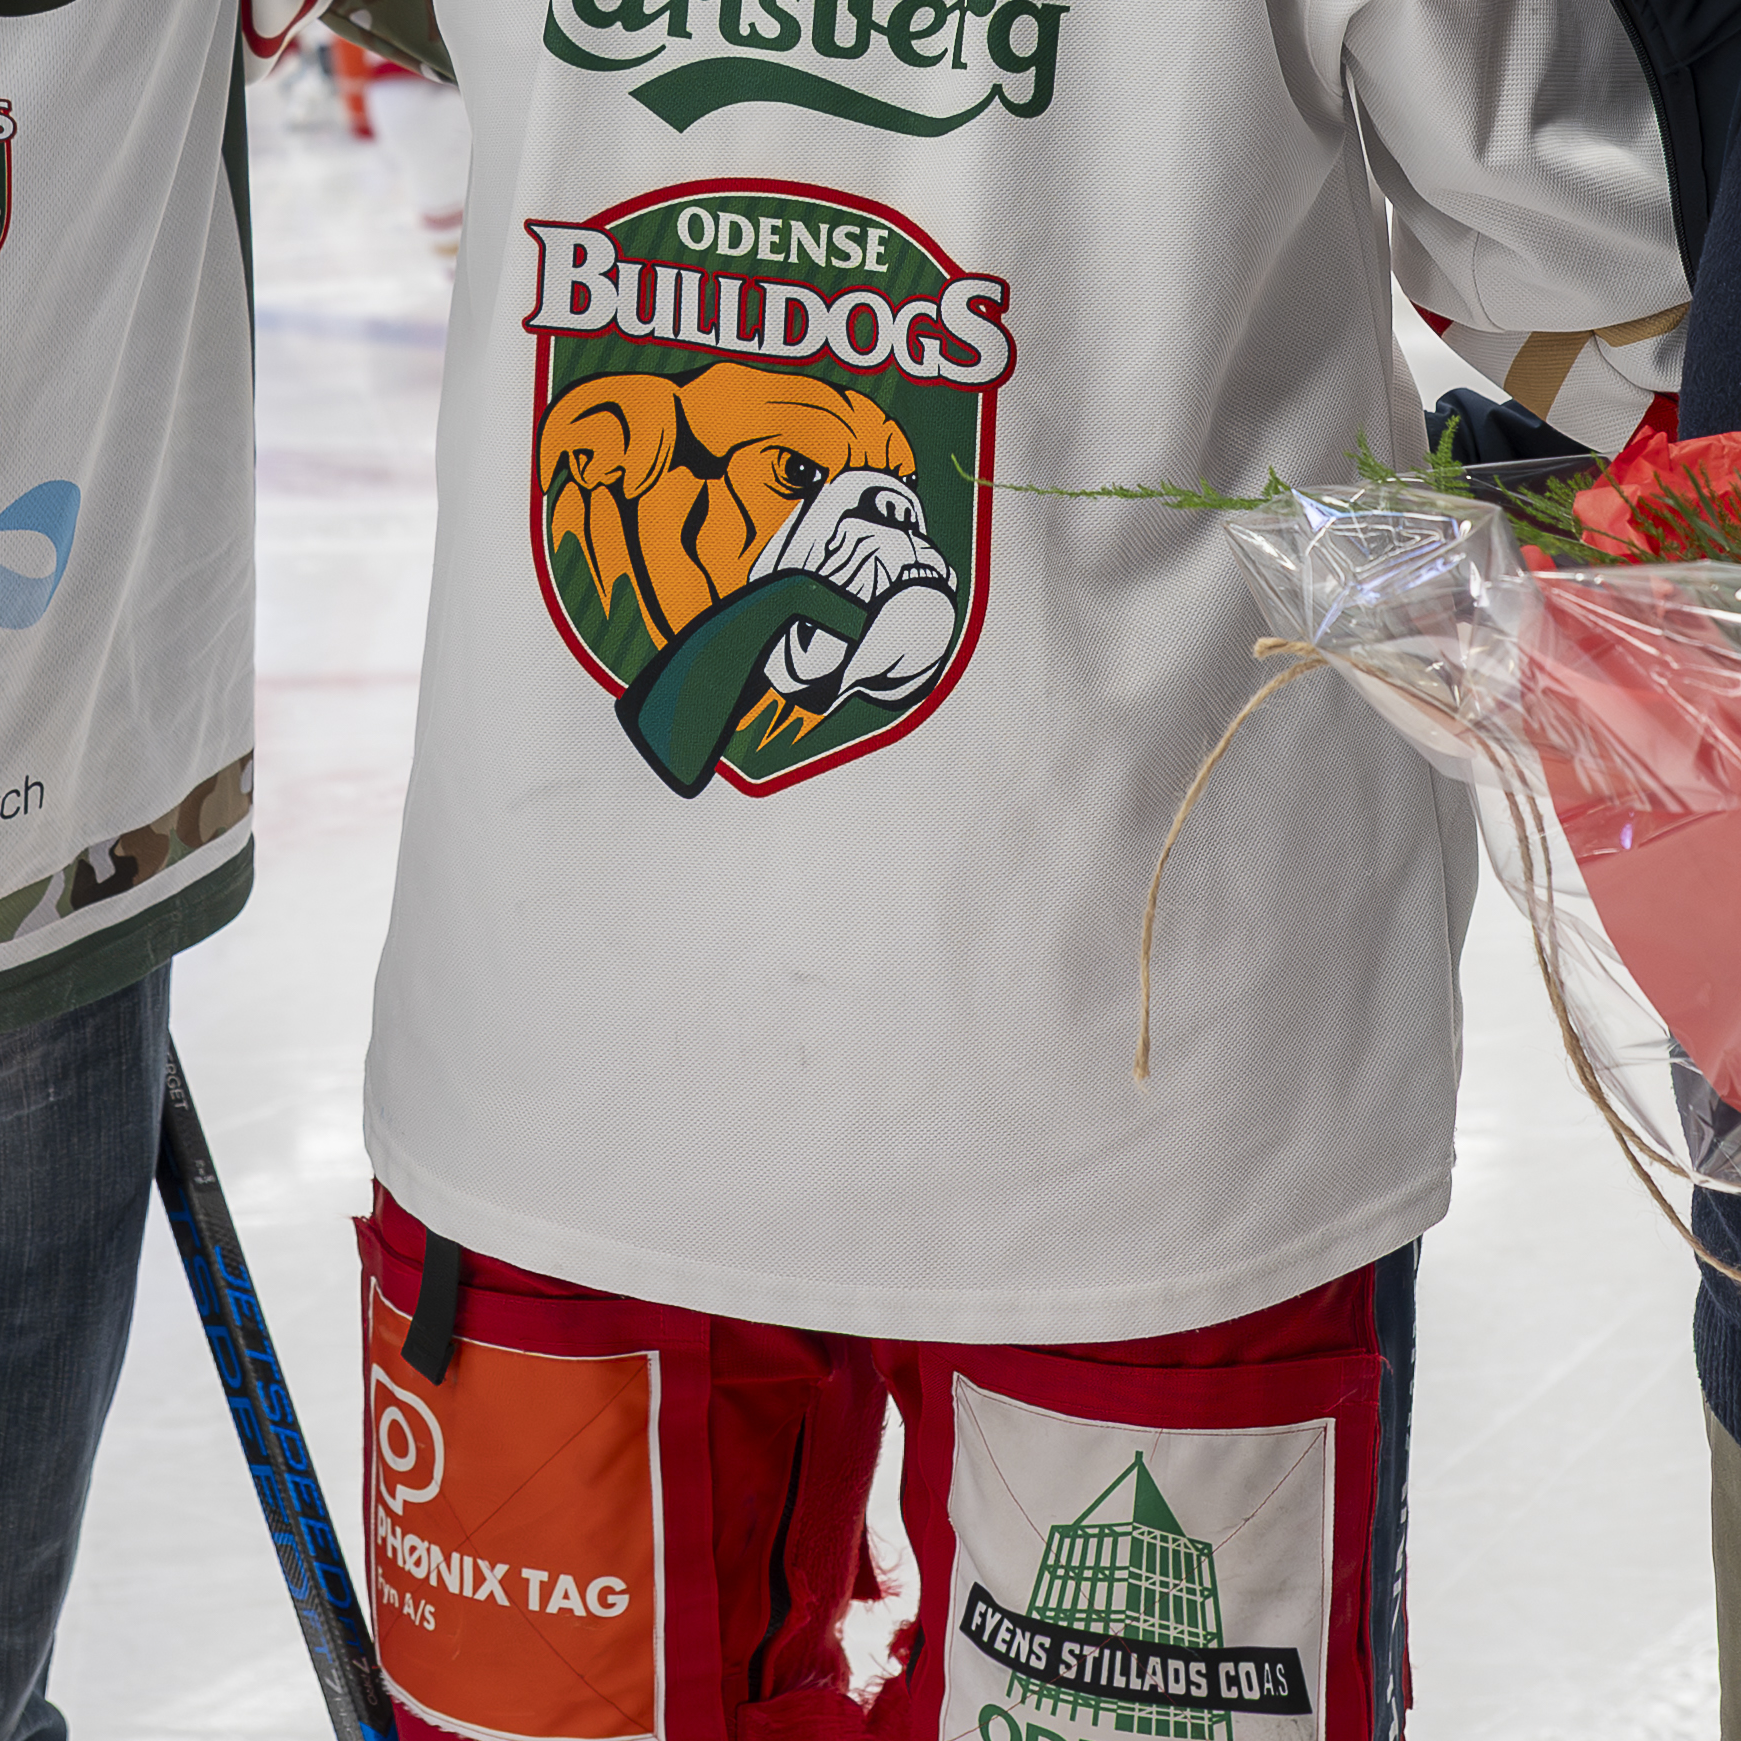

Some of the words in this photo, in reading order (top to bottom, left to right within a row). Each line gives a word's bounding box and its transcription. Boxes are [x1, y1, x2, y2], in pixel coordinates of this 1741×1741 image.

[676, 205, 889, 273] ODENSE
[527, 223, 1012, 388] BULLDOGS
[377, 1503, 511, 1608] PHØNIX
[521, 1567, 630, 1618] TAG
[403, 1592, 436, 1632] A/S
[970, 1600, 1052, 1670] FYENS
[1058, 1640, 1210, 1698] STILLADS
